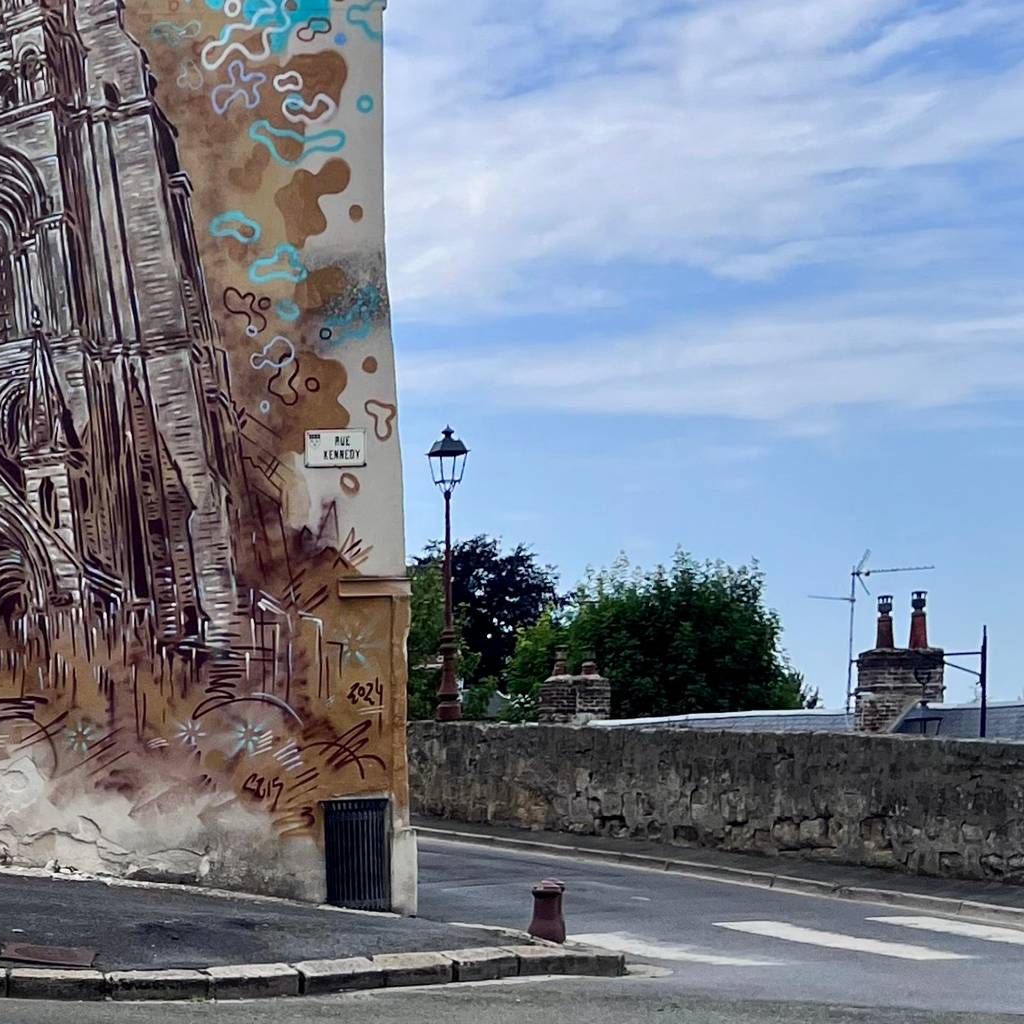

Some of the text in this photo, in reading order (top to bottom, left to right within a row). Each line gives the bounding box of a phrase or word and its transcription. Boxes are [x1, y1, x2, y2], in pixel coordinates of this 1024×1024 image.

[334, 435, 351, 446] RUE
[323, 449, 360, 460] KENNEDY
[347, 676, 384, 714] 2024
